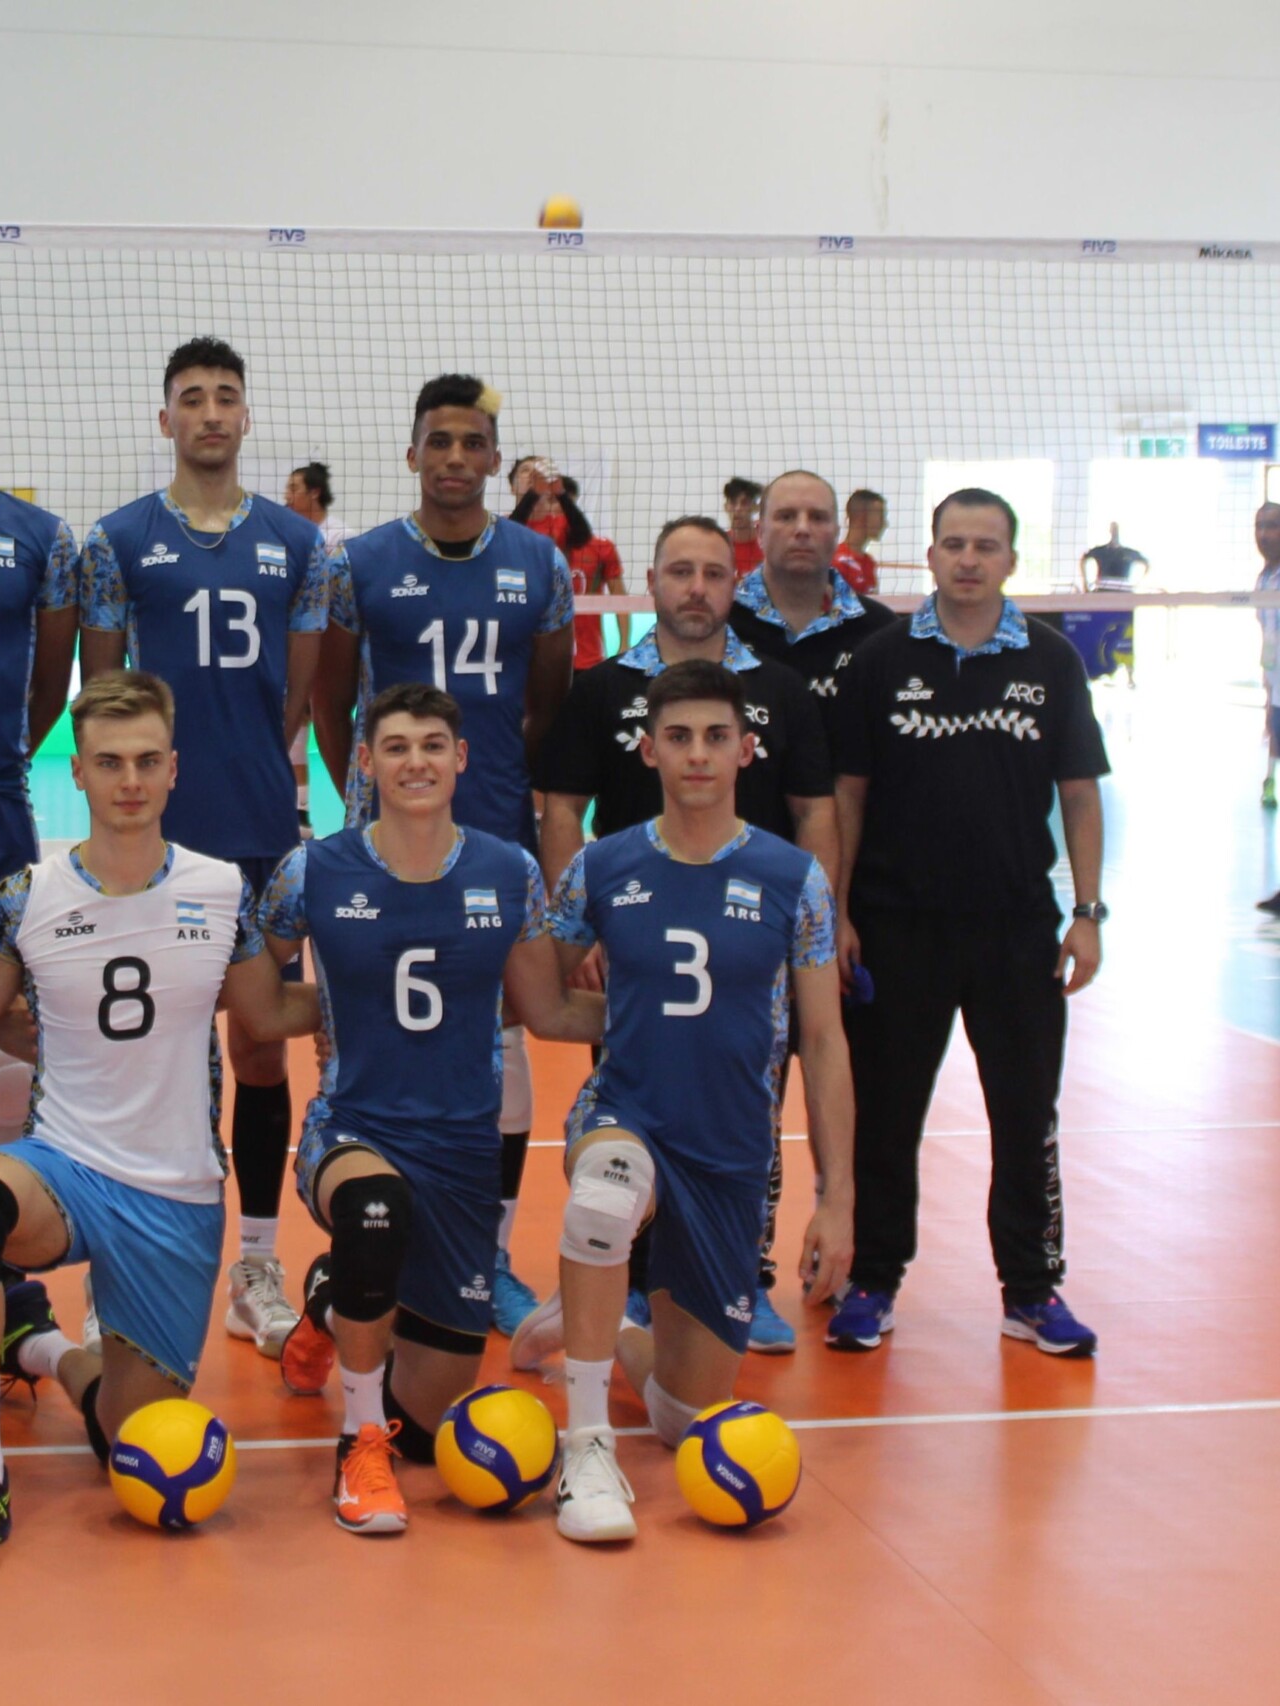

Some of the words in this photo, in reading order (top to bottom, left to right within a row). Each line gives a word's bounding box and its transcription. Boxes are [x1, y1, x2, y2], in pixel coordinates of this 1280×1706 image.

[268, 228, 306, 242] FIVB
[547, 232, 583, 245] FIVB
[818, 236, 854, 249] FIVB
[1081, 239, 1117, 253] FIVB
[1207, 435, 1267, 450] TOILETTE
[258, 563, 287, 578] ARG
[496, 591, 527, 605] ARG
[183, 588, 261, 668] 13
[418, 618, 503, 695] 14
[1004, 682, 1045, 706] ARG
[745, 703, 769, 725] RG
[465, 915, 502, 929] ARG
[724, 904, 761, 922] ARG
[177, 928, 211, 940] ARG
[662, 928, 713, 1017] 3
[97, 955, 156, 1042] 8
[395, 948, 443, 1031] 6
[207, 1435, 219, 1460] FIVB
[473, 1439, 497, 1459] FIVB
